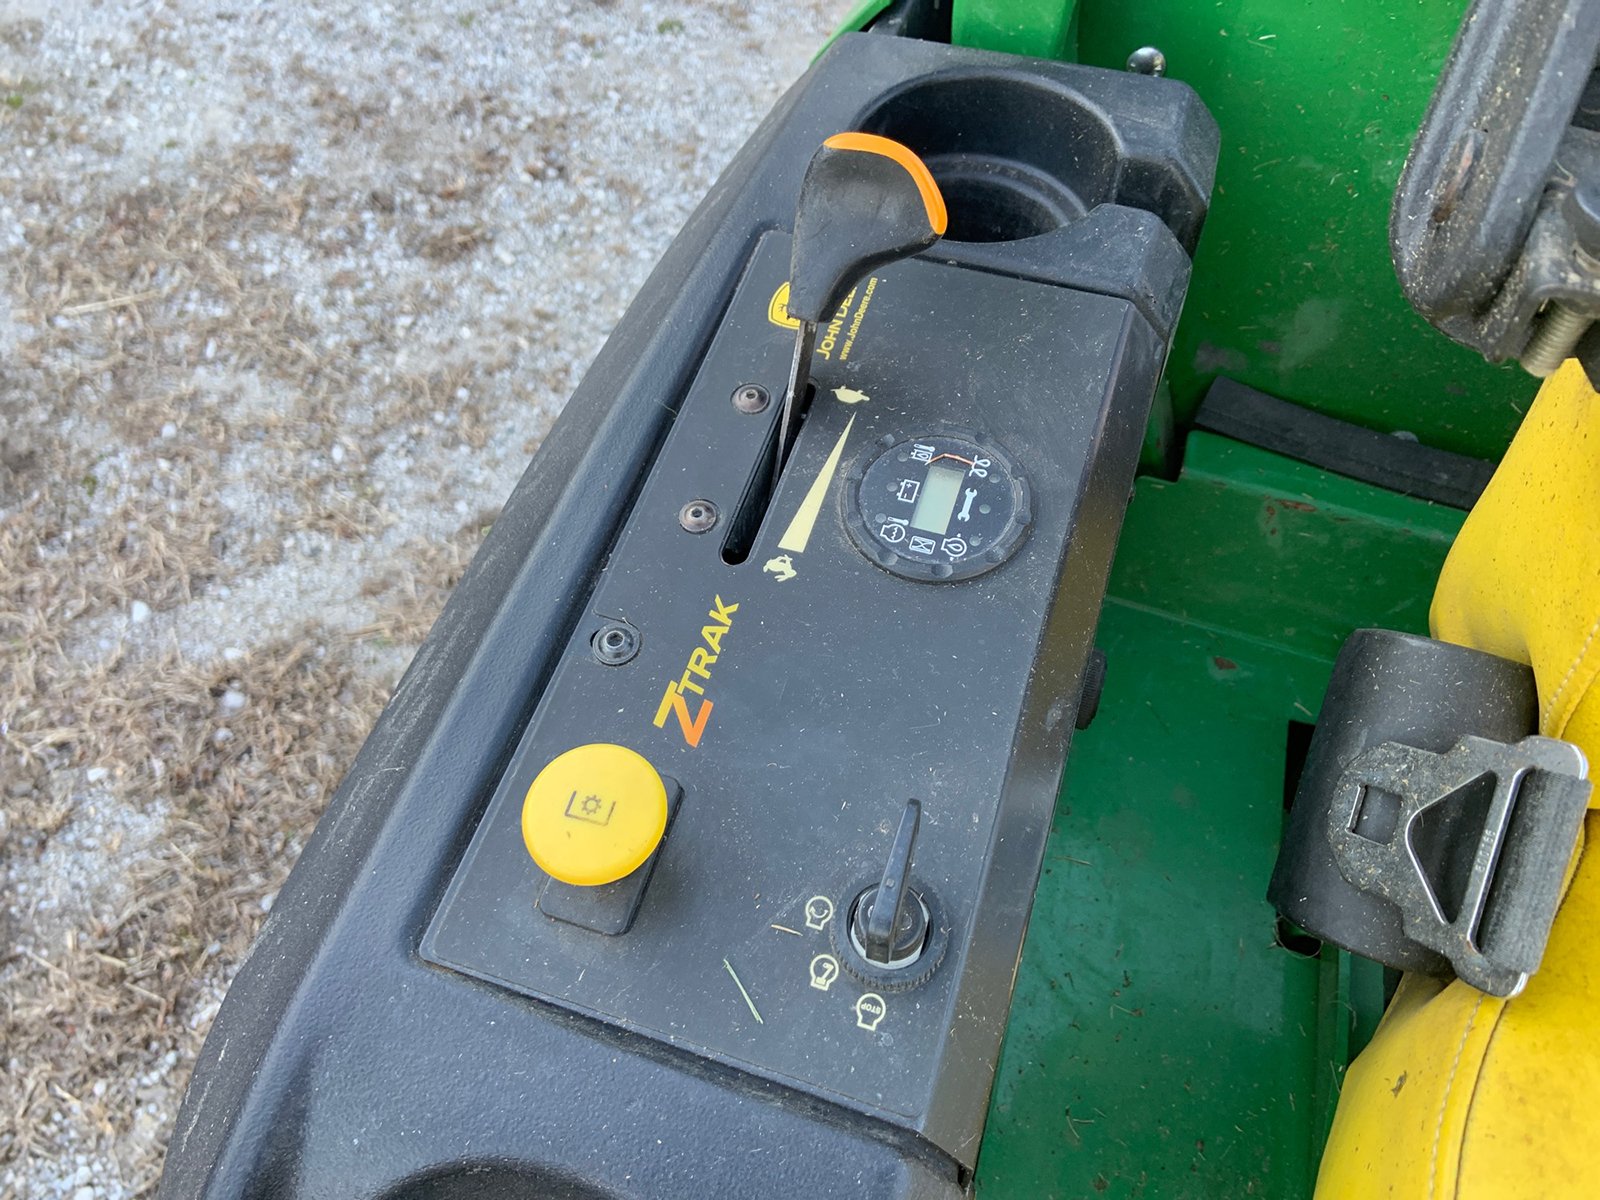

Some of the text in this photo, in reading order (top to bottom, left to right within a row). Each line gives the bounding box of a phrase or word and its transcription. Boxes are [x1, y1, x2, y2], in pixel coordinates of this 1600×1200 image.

[839, 277, 878, 360] www.JohnDeere.com
[816, 319, 843, 360] JOHN
[860, 1001, 882, 1015] STOP
